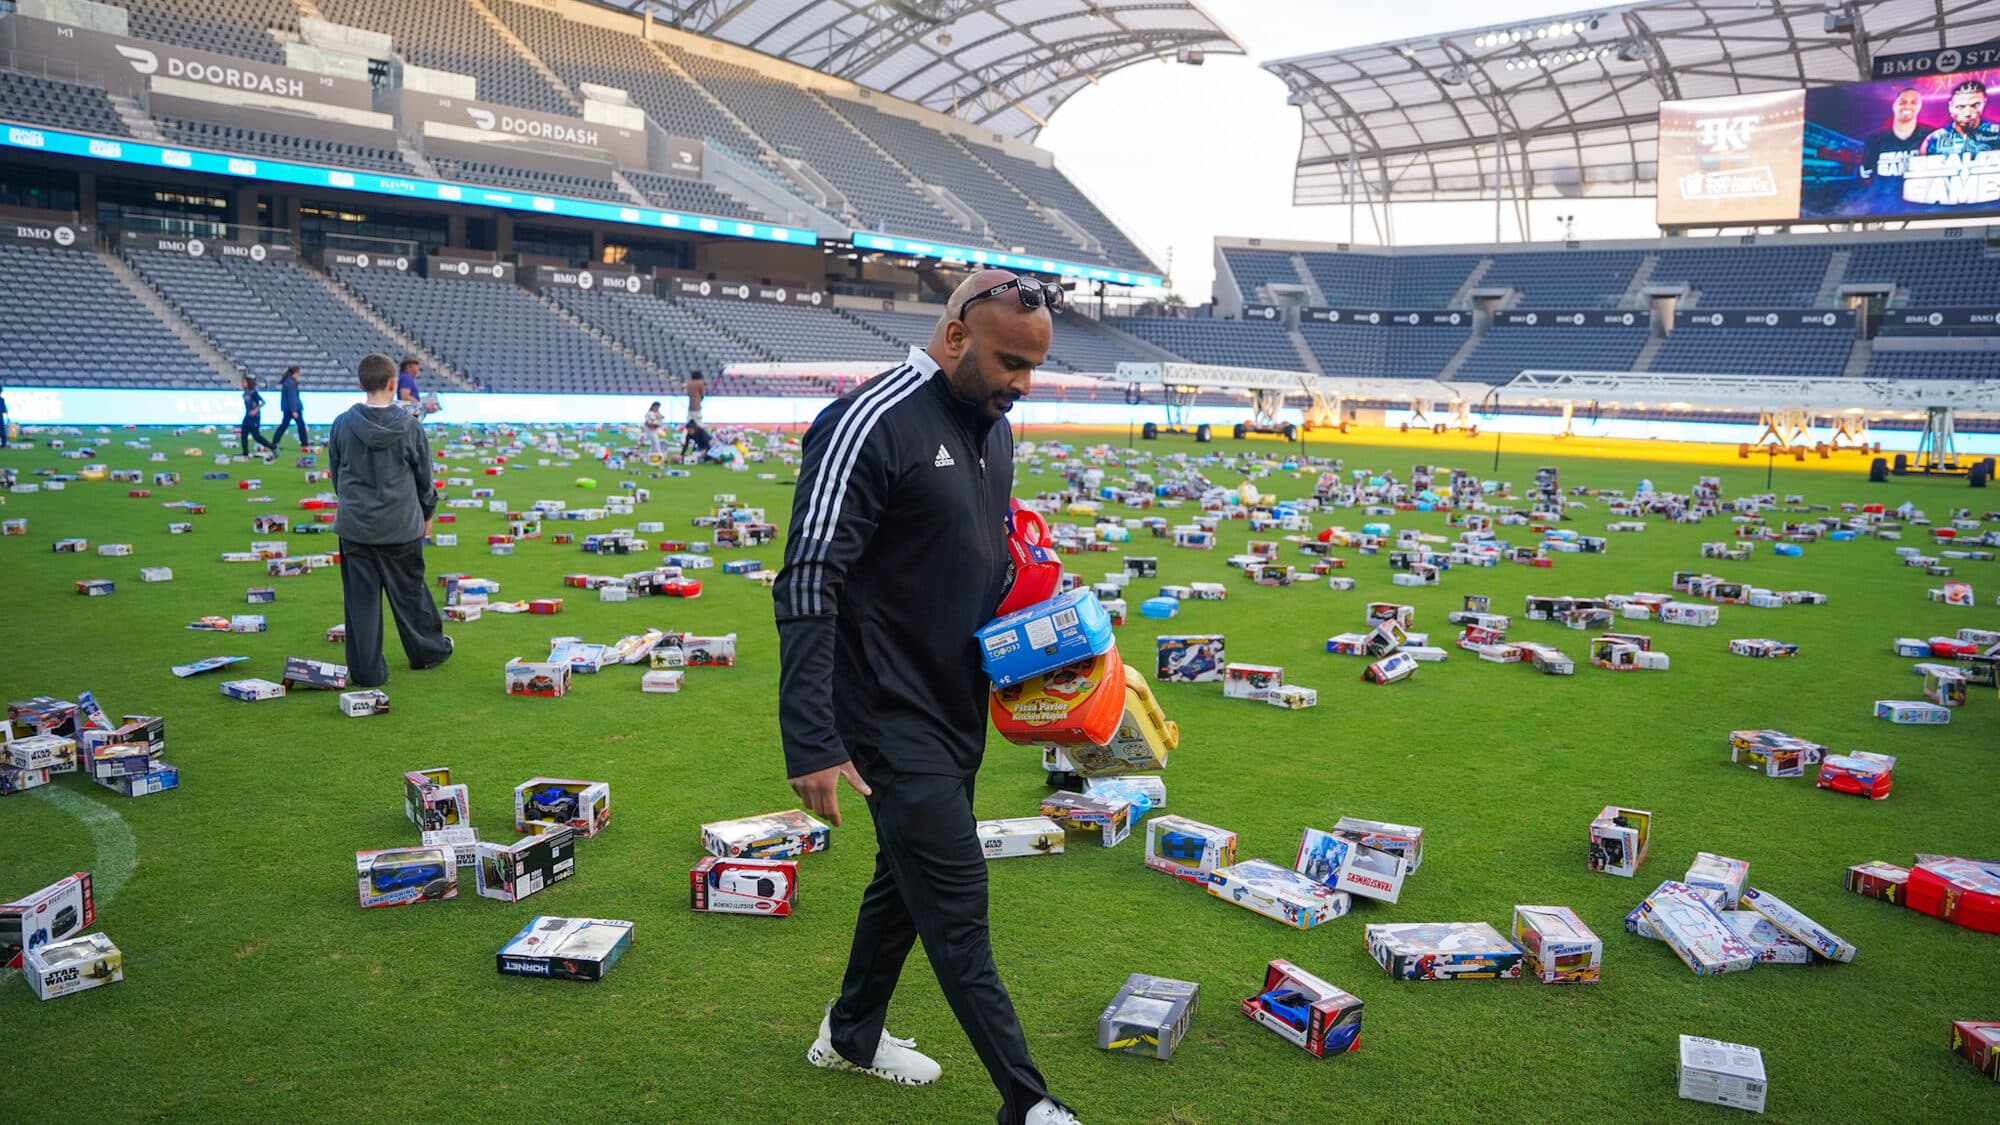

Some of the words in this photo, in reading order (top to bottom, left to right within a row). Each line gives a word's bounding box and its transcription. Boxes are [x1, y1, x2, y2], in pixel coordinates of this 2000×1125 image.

[57, 27, 74, 39] M1
[1881, 57, 1932, 75] BMO
[168, 57, 304, 98] DOORDASH
[501, 115, 598, 146] DOORDASH
[17, 226, 51, 240] BMO
[158, 239, 186, 251] BMO
[223, 245, 249, 257] BMO
[553, 272, 577, 284] BMO
[602, 277, 626, 288] BMO
[1905, 314, 1928, 324] BMO
[1970, 314, 1994, 323] BMO
[1014, 703, 1038, 712] Pizza
[1039, 702, 1069, 712] Parlor
[1012, 711, 1041, 721] Kitchen
[1346, 872, 1393, 893] TRANSFORMERS
[363, 888, 416, 906] LAMBORGHINI
[504, 961, 549, 974] HORNET
[45, 967, 80, 981] STAR
[45, 974, 79, 986] WARS
